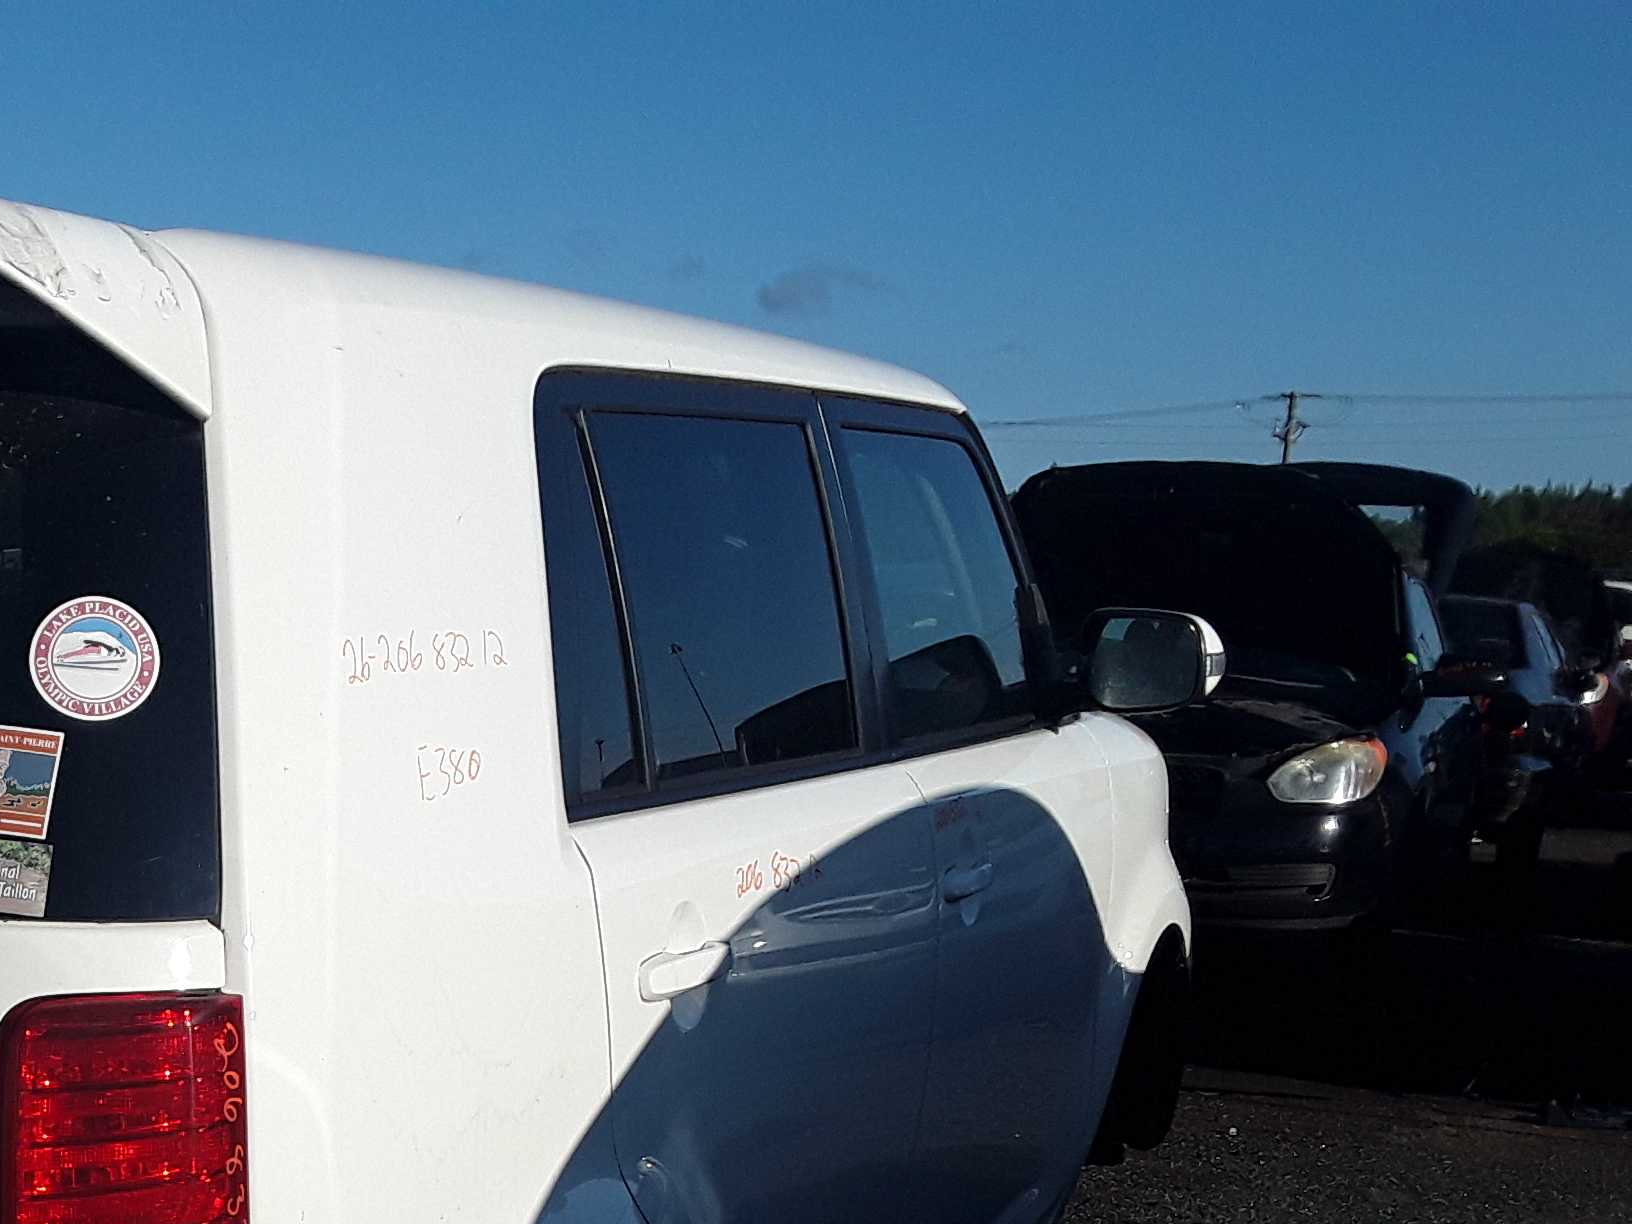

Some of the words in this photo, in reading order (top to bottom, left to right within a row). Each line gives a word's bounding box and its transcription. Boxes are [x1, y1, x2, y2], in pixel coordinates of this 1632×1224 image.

[44, 604, 82, 638] LAKE
[84, 602, 141, 632] PLACID
[137, 634, 154, 663] USA
[36, 656, 81, 712] OLYMPIC
[82, 681, 147, 716] VILLAGE
